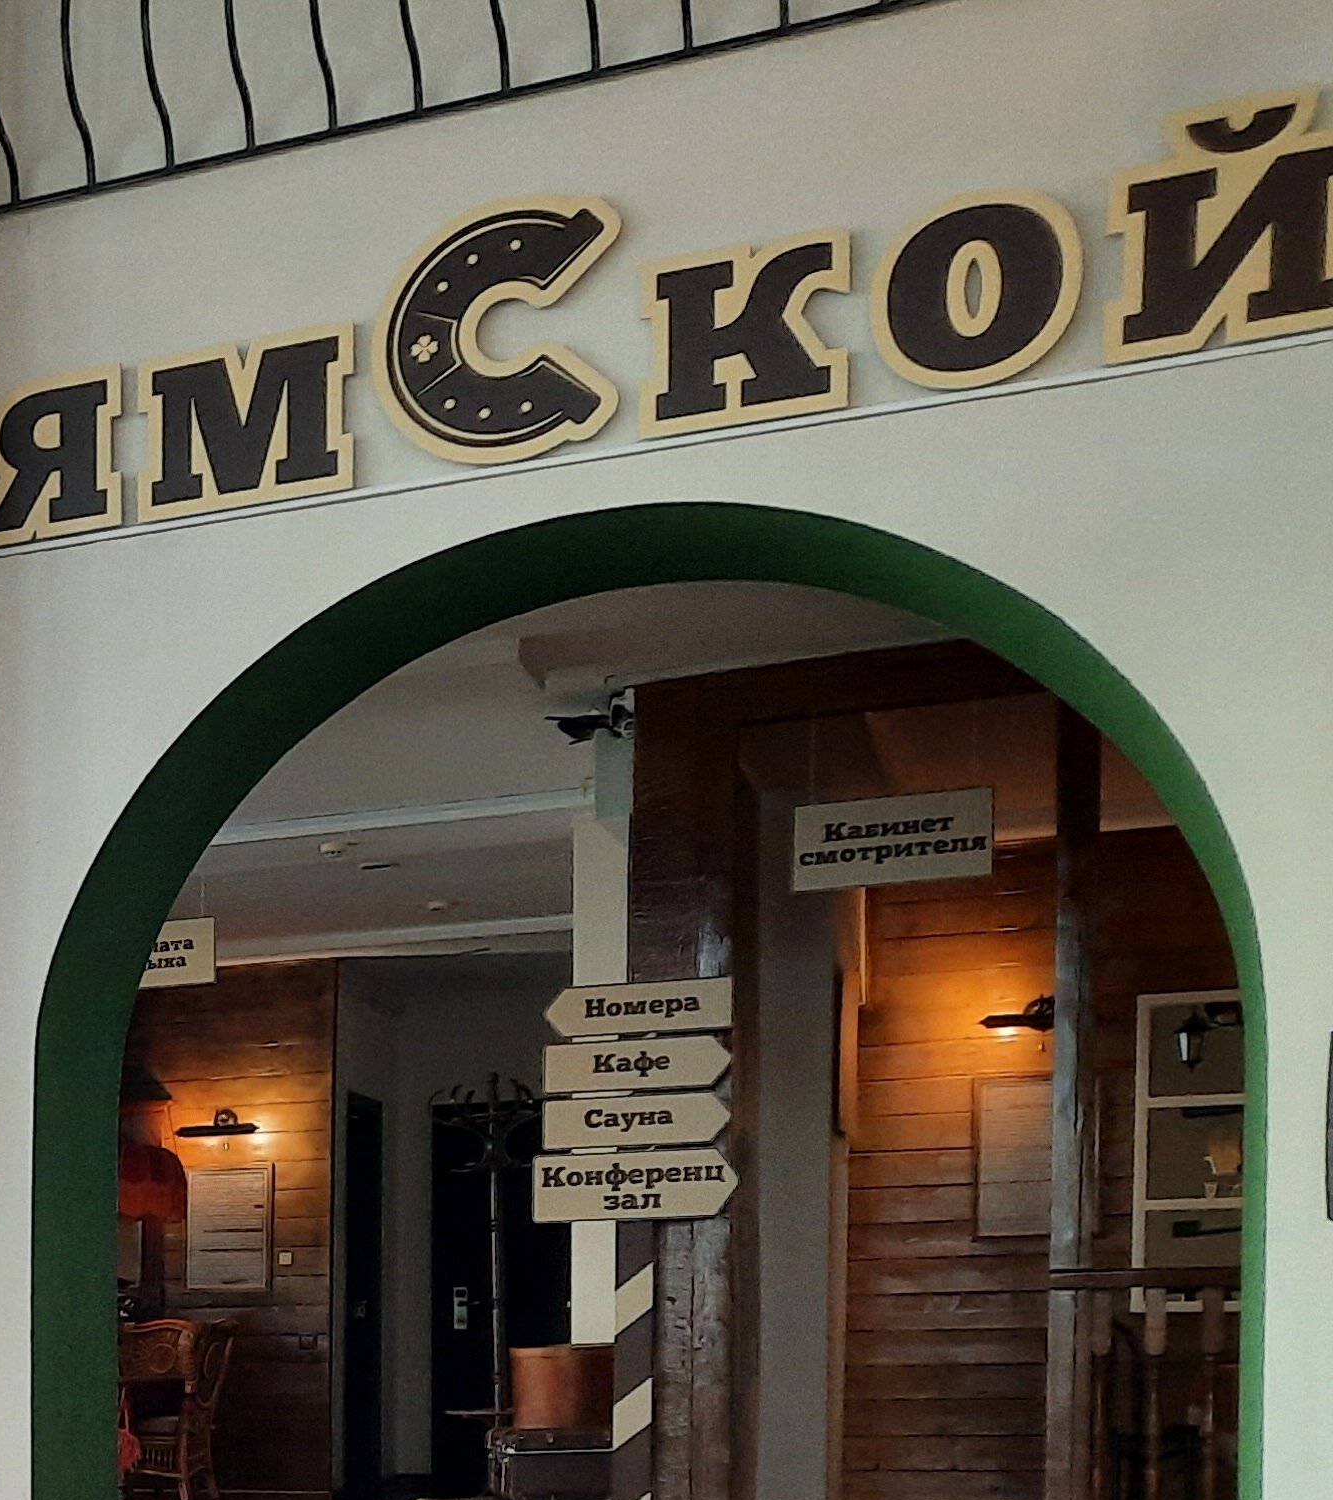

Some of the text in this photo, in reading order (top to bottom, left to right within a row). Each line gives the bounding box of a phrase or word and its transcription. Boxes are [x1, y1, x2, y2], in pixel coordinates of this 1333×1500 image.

[821, 816, 955, 844] Кабинет
[798, 835, 988, 867] смотрителя
[584, 996, 701, 1019] Номера
[592, 1051, 671, 1078] Кафе
[584, 1108, 674, 1133] Сауна
[541, 1162, 727, 1192] Конференц
[602, 1192, 662, 1211] зал
